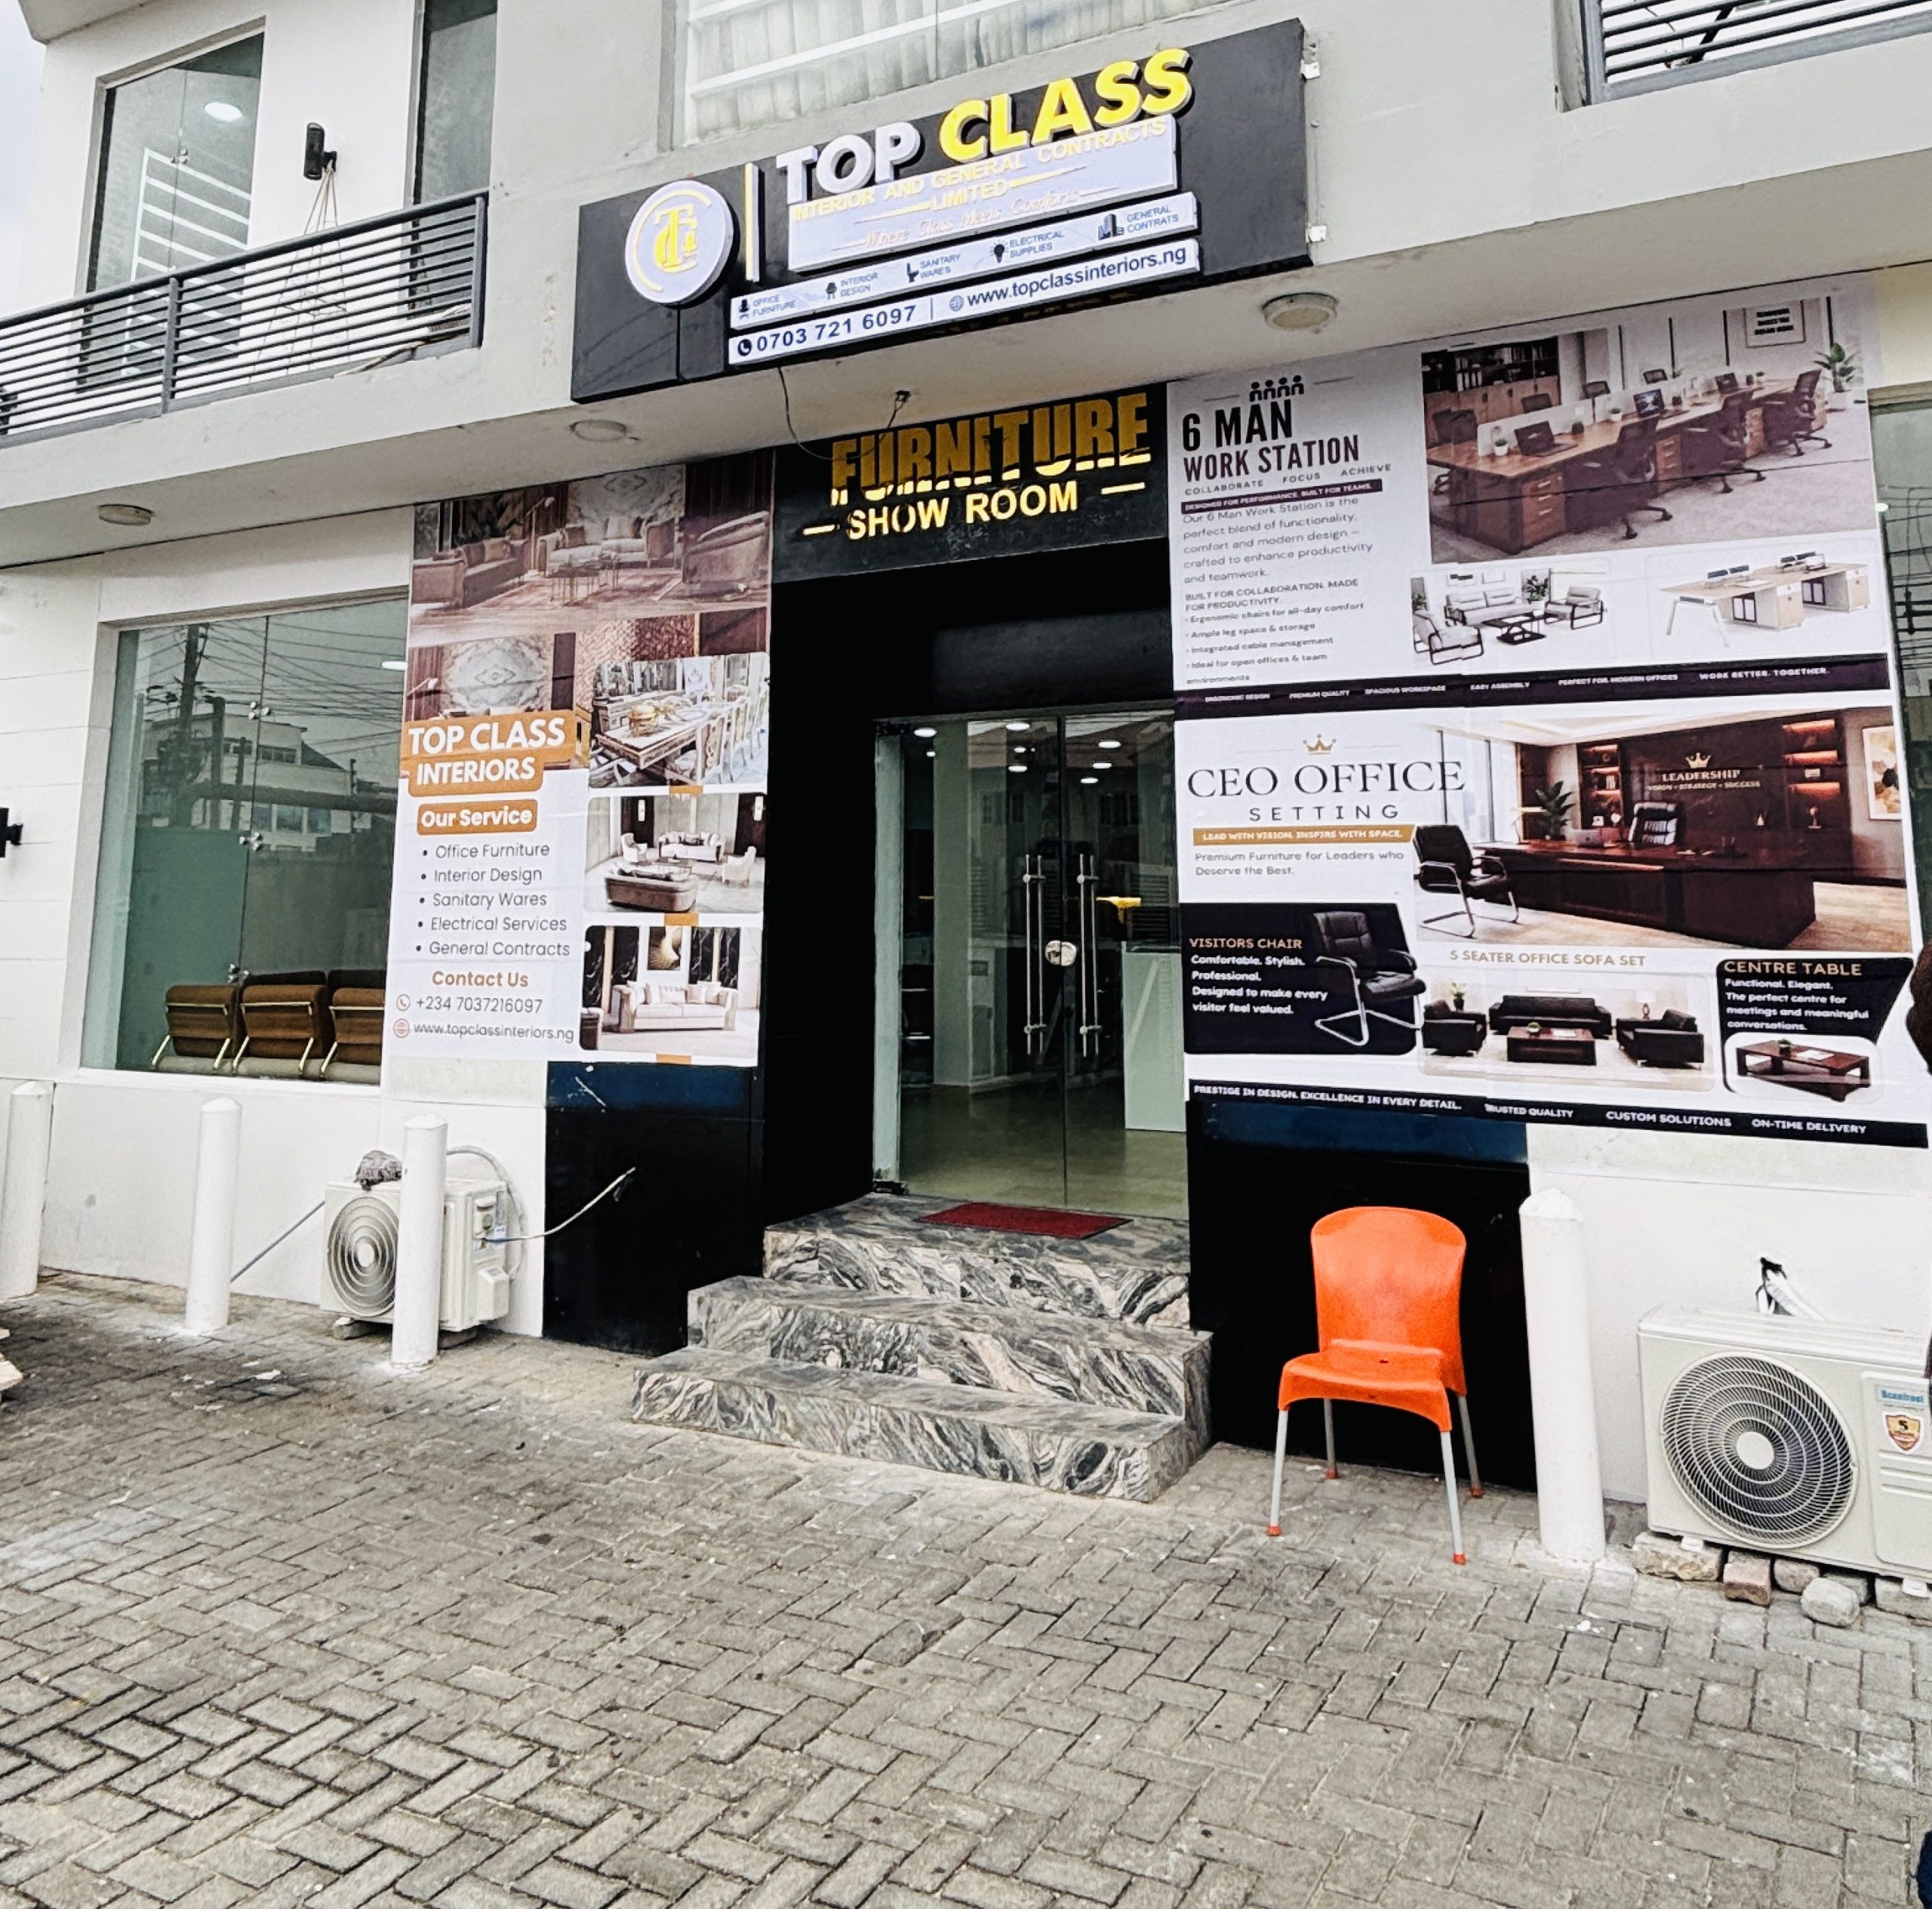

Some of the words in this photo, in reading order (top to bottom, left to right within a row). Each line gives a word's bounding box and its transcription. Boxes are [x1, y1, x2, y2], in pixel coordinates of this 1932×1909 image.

[776, 122, 921, 204] TOP
[940, 48, 1192, 164] CLASS
[795, 190, 876, 221] INTERIOR
[884, 180, 924, 202] AND
[931, 153, 1028, 189] GENERAL
[1038, 119, 1167, 164] CONTRACTS
[931, 180, 1008, 211] LIMITED
[1127, 205, 1172, 223] GENERAL
[865, 229, 910, 248] Where
[917, 218, 954, 238] Class
[961, 206, 1002, 227] Meets
[1127, 214, 1180, 234] CONTRATS
[1009, 230, 1065, 248] ELECTRICAL
[1009, 242, 1054, 259] SUPPLIES
[920, 253, 961, 269] SANITARY
[840, 272, 878, 287] INTERIOR
[920, 266, 951, 279] WARES
[967, 247, 1186, 306] www.topclassinteriors.ng
[840, 284, 872, 297] DESIGN
[752, 294, 780, 306] OFFICE
[752, 299, 796, 317] FURNITURE
[757, 328, 807, 352] 0703
[814, 318, 852, 340] 721
[863, 305, 917, 330] 6097
[1182, 413, 1201, 451] 6
[1215, 399, 1293, 448] MAN
[831, 393, 1151, 507] FURNITURE
[1183, 449, 1250, 483] WORK
[1258, 434, 1359, 474] STATION
[1282, 472, 1321, 485] FOCUS
[1340, 463, 1392, 478] ACHIEVE
[1184, 479, 1263, 497] COLLABORATE
[847, 497, 949, 540] SHOW
[965, 481, 1078, 525] ROOM
[1183, 514, 1204, 525] Our
[1207, 512, 1215, 522] 6
[1217, 510, 1242, 521] Man
[1245, 507, 1275, 518] Work
[1279, 500, 1322, 514] Station
[1324, 498, 1335, 509] is
[1338, 496, 1359, 507] the
[1183, 526, 1224, 540] perfect
[1228, 522, 1261, 534] blend
[1264, 521, 1276, 531] of
[1183, 541, 1229, 554] comfort
[1232, 538, 1254, 549] and
[1257, 534, 1303, 546] modern
[1307, 529, 1348, 543] design
[1183, 556, 1225, 569] crafted
[1229, 555, 1241, 565] to
[1244, 551, 1294, 563] enhance
[1297, 542, 1373, 559] productivity
[1183, 574, 1205, 584] and
[1186, 591, 1211, 601] BUILT
[1214, 590, 1234, 599] FOR
[1327, 577, 1358, 589] MADE
[1186, 602, 1204, 611] FOR
[1208, 596, 1281, 610] PRODUCTIVITY
[1190, 612, 1238, 624] Ergonomic
[1241, 609, 1271, 620] chairs
[1272, 608, 1286, 617] for
[1324, 602, 1364, 613] comfort
[1191, 629, 1220, 640] Ample
[1223, 628, 1236, 638] leg
[1238, 626, 1266, 637] space
[1278, 623, 1316, 634] storage
[1191, 643, 1239, 655] Integrated
[1241, 641, 1268, 651] cable
[1270, 636, 1334, 650] management
[1191, 660, 1214, 670] Ideal
[1216, 659, 1229, 668] for
[1231, 658, 1255, 669] open
[1257, 654, 1289, 665] offices
[1302, 652, 1327, 662] team
[1186, 675, 1251, 685] environments
[408, 725, 464, 755] TOP
[469, 717, 566, 752] CLASS
[417, 756, 536, 786] INTERIORS
[1188, 766, 1278, 797] CEO
[1294, 761, 1466, 796] OFFICE
[1662, 769, 1740, 782] LEADERSHIP
[420, 810, 457, 828] Our
[459, 805, 533, 827] Service
[1249, 804, 1399, 822] SETTING
[1202, 833, 1227, 841] LEAD
[1228, 831, 1254, 841] WITH
[1296, 830, 1337, 839] INSPIRE
[1339, 830, 1367, 839] WITH
[435, 844, 478, 859] Office
[482, 843, 550, 858] Furniture
[1195, 852, 1245, 862] Premium
[1249, 851, 1302, 861] Furniture
[1306, 850, 1321, 861] for
[1326, 851, 1375, 861] Leaders
[1378, 851, 1404, 860] who
[434, 869, 486, 882] Interior
[490, 867, 543, 885] Design
[1195, 867, 1241, 876] Deserve
[1244, 866, 1263, 876] the
[1266, 866, 1295, 876] Best.
[432, 892, 494, 910] Sanitary
[498, 892, 547, 907] Wares
[430, 916, 498, 931] Electrical
[502, 916, 568, 931] Services
[429, 941, 488, 955] General
[492, 941, 571, 957] Contracts
[1189, 938, 1254, 949] VISITORS
[1257, 938, 1303, 949] CHAIR
[1191, 954, 1263, 965] Comfortable.
[1265, 955, 1306, 968] Stylish.
[1462, 950, 1515, 963] SEATER
[1518, 952, 1569, 965] OFFICE
[1574, 953, 1615, 965] SOFA
[1619, 955, 1646, 967] SET
[1192, 971, 1263, 982] Professional.
[1724, 961, 1797, 975] CENTRE
[1802, 962, 1862, 976] TABLE
[432, 970, 503, 987] Contact
[506, 971, 529, 988] Us
[1724, 978, 1785, 989] Functional.
[1192, 986, 1244, 999] Designed
[1246, 989, 1258, 998] to
[1260, 988, 1292, 999] make
[1294, 990, 1328, 1002] every
[1725, 991, 1746, 1002] The
[1748, 993, 1789, 1004] perfect
[1790, 994, 1827, 1004] centre
[1829, 995, 1847, 1005] for
[416, 996, 451, 1011] +234
[456, 996, 543, 1014] 7037216097
[1192, 1002, 1227, 1012] visitor
[1229, 1003, 1251, 1013] feel
[1252, 1005, 1294, 1015] valued.
[1726, 1006, 1777, 1018] meetings
[1780, 1008, 1802, 1018] and
[1804, 1008, 1869, 1020] meaningful
[414, 1023, 574, 1044] www.topclassinteriors.ng
[1727, 1021, 1807, 1031] conversations.
[1193, 1085, 1241, 1096] PRESTIGE
[1242, 1088, 1256, 1097] IN
[1300, 1091, 1364, 1104] EXCELLENCE
[1367, 1095, 1381, 1105] IN
[1383, 1096, 1417, 1108] EVERY
[1419, 1098, 1463, 1110] DETAIL.
[1484, 1103, 1527, 1115] TRUSTED
[1528, 1107, 1574, 1119] QUALITY
[1605, 1110, 1657, 1123] CUSTOM
[1660, 1114, 1732, 1128] SOLUTIONS
[1752, 1118, 1804, 1132] ON-TIME
[1807, 1122, 1867, 1135] DELIVERY
